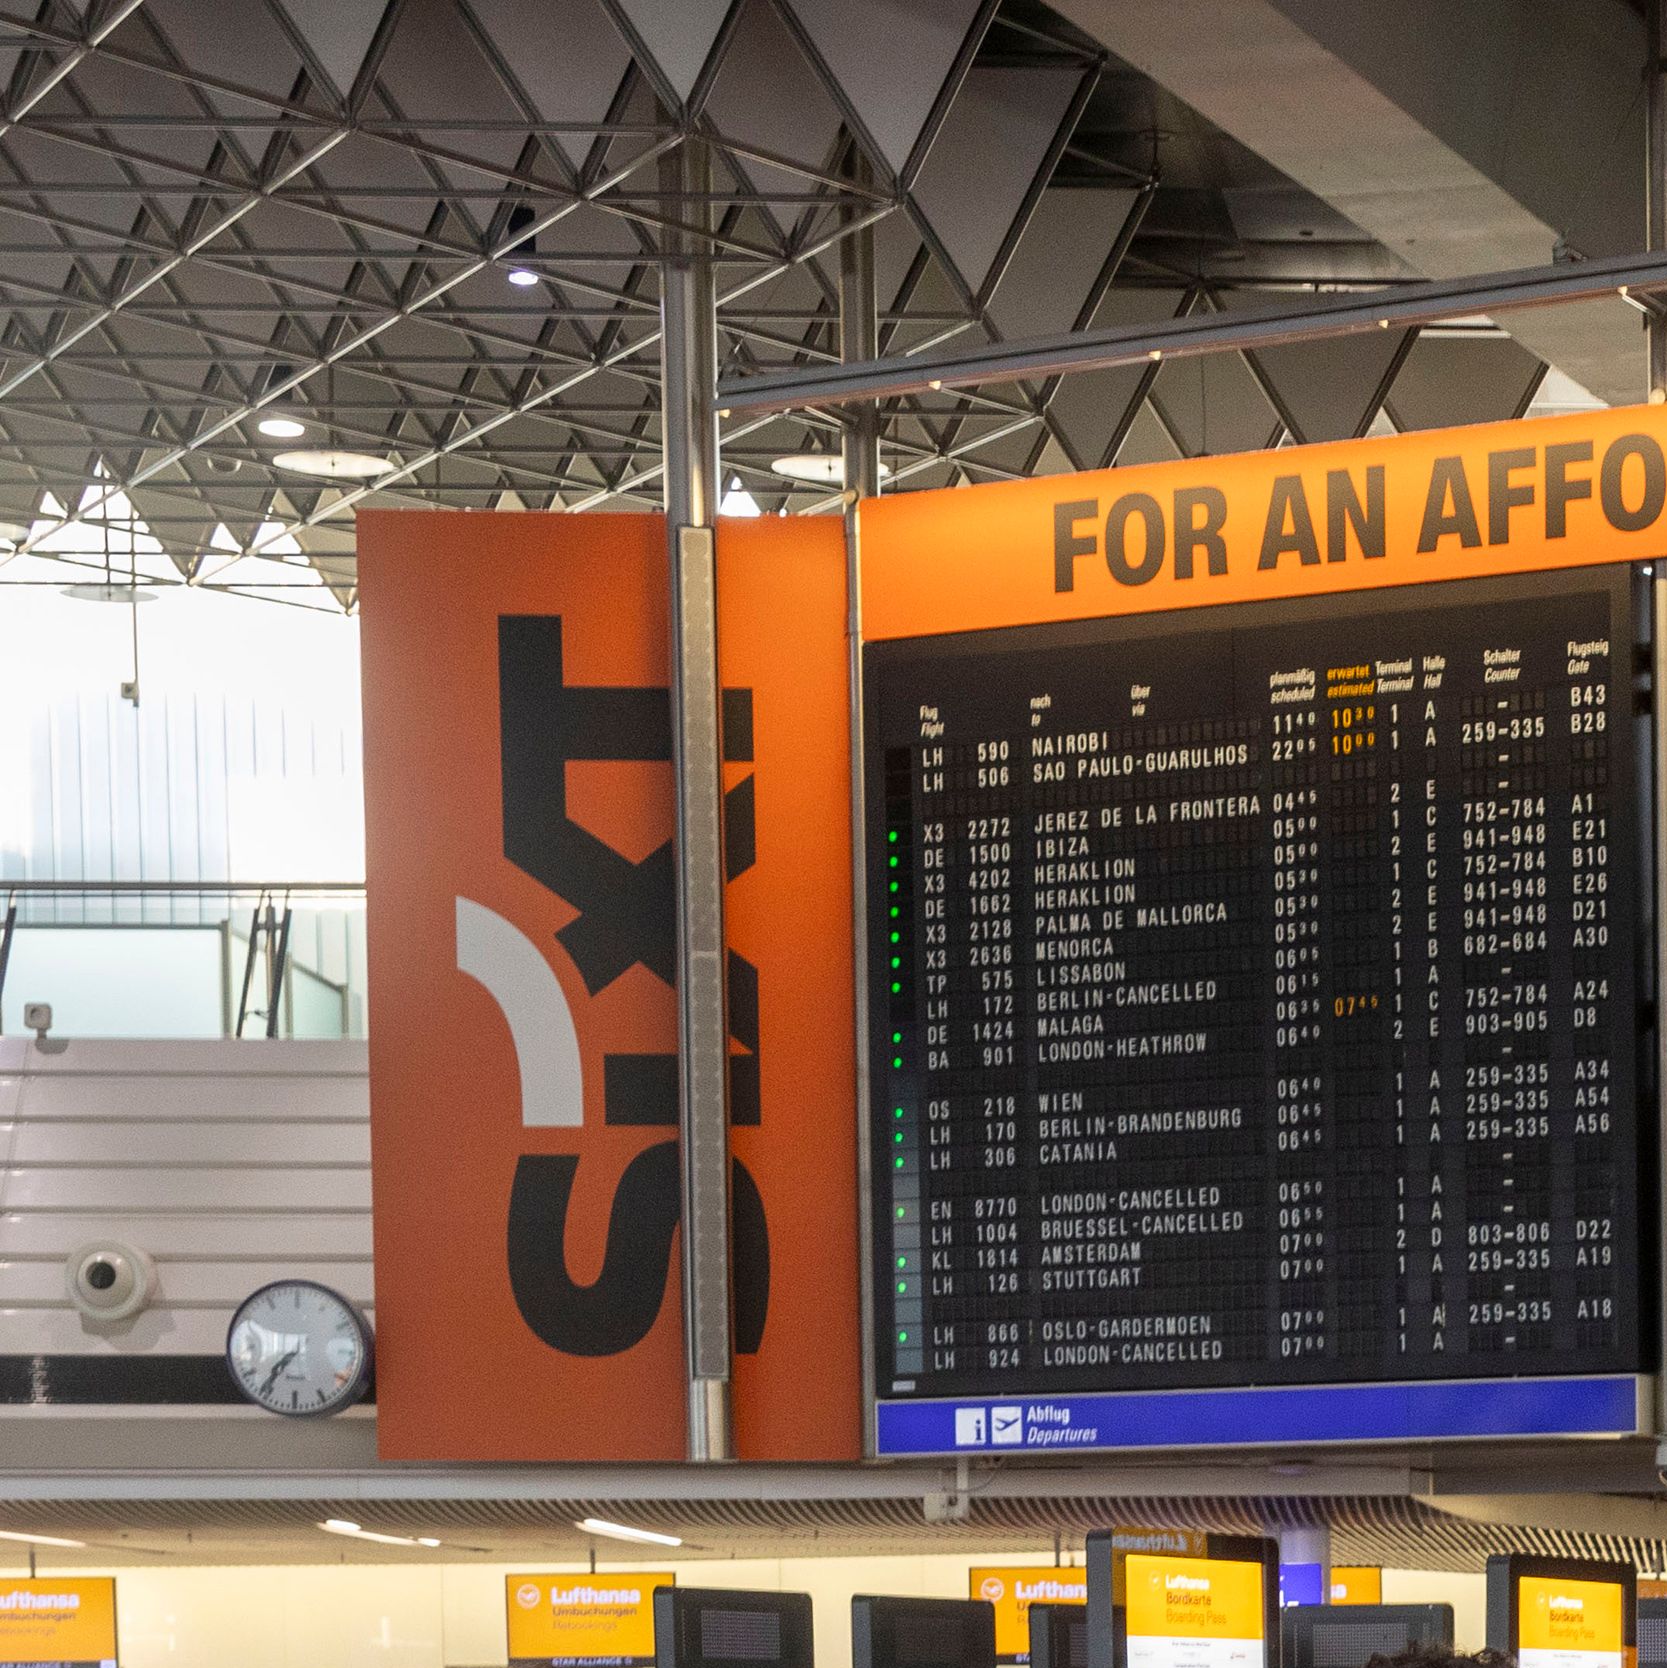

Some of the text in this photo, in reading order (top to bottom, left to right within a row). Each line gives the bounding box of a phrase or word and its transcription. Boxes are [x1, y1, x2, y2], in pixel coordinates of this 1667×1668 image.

[1054, 489, 1229, 594] FOR
[1257, 468, 1387, 571] AN
[922, 746, 944, 768] LH
[977, 740, 1010, 763] 590
[1031, 731, 1108, 757] NAIROBI
[1390, 703, 1398, 724] 1
[1423, 699, 1437, 721] A
[1569, 683, 1607, 708] B43
[1032, 743, 1248, 784] SAO PAULO-GUARULHOS
[498, 614, 771, 1356] SIXT
[1036, 979, 1217, 1012] BERLIN-CANCELLED
[1037, 1032, 1207, 1063] LONDON-HEATHROW
[1039, 1141, 1118, 1165] CATANIA
[1040, 1210, 1244, 1240] BRUESSEL-CANCELLED
[1042, 1266, 1142, 1291] STUTTGART
[1042, 1314, 1211, 1341] OSLO-GARDERMOEN
[1027, 1405, 1070, 1426] Abflug
[1027, 1426, 1098, 1446] Departures
[551, 1586, 641, 1605] Lufthansa
[1166, 1591, 1212, 1607] Bordkarte
[1166, 1609, 1204, 1627] Boarding
